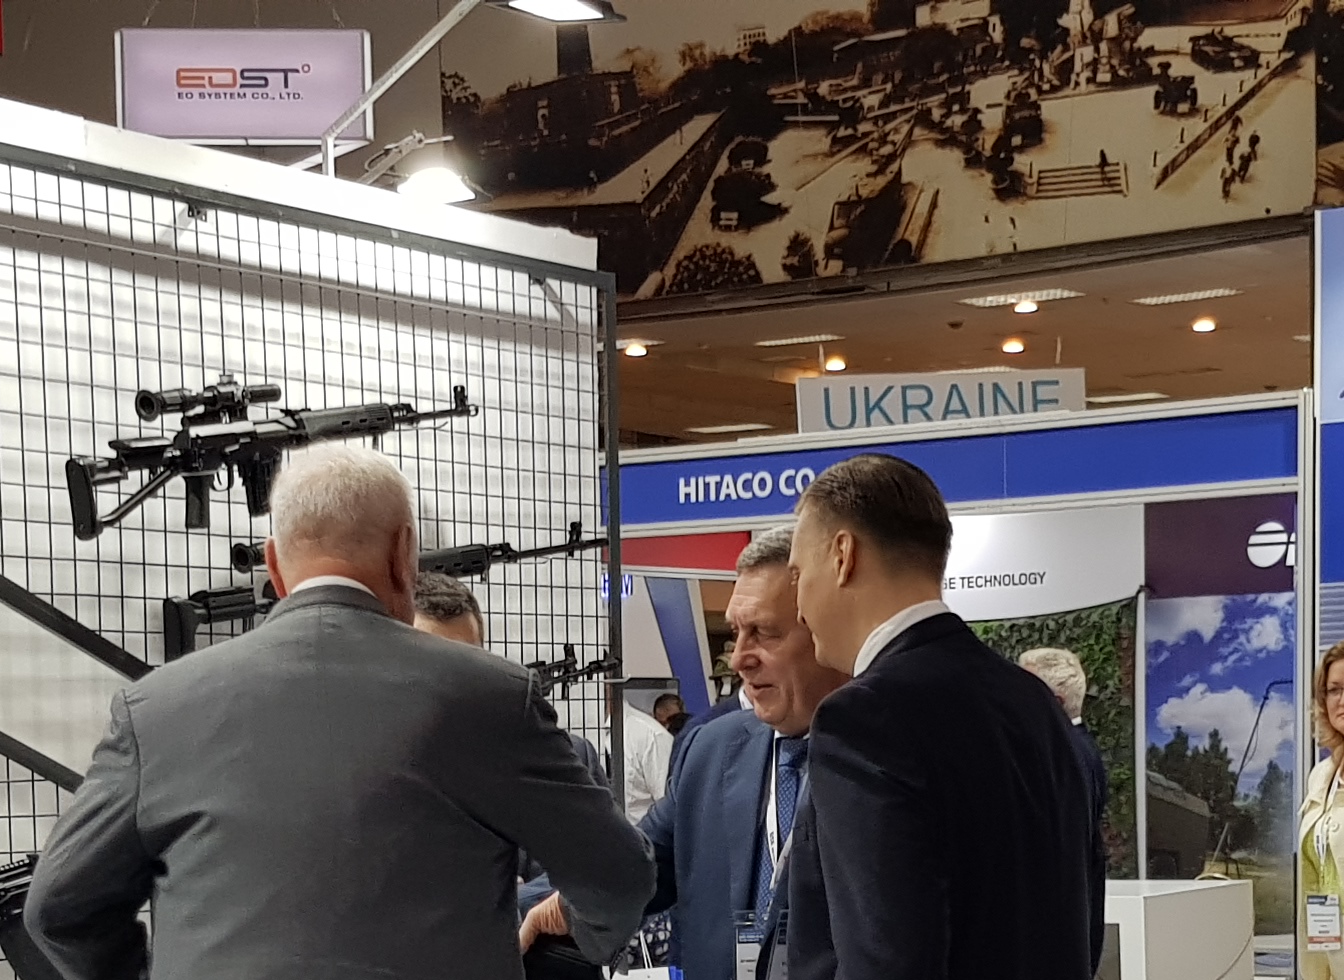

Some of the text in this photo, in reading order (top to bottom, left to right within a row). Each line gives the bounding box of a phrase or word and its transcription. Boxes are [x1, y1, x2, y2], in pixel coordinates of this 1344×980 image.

[177, 92, 194, 100] EO
[198, 92, 247, 100] SYSTEM
[822, 379, 1060, 431] UKRAINE
[678, 470, 774, 505] HITACO
[959, 571, 1047, 590] TECHNOLOGY
